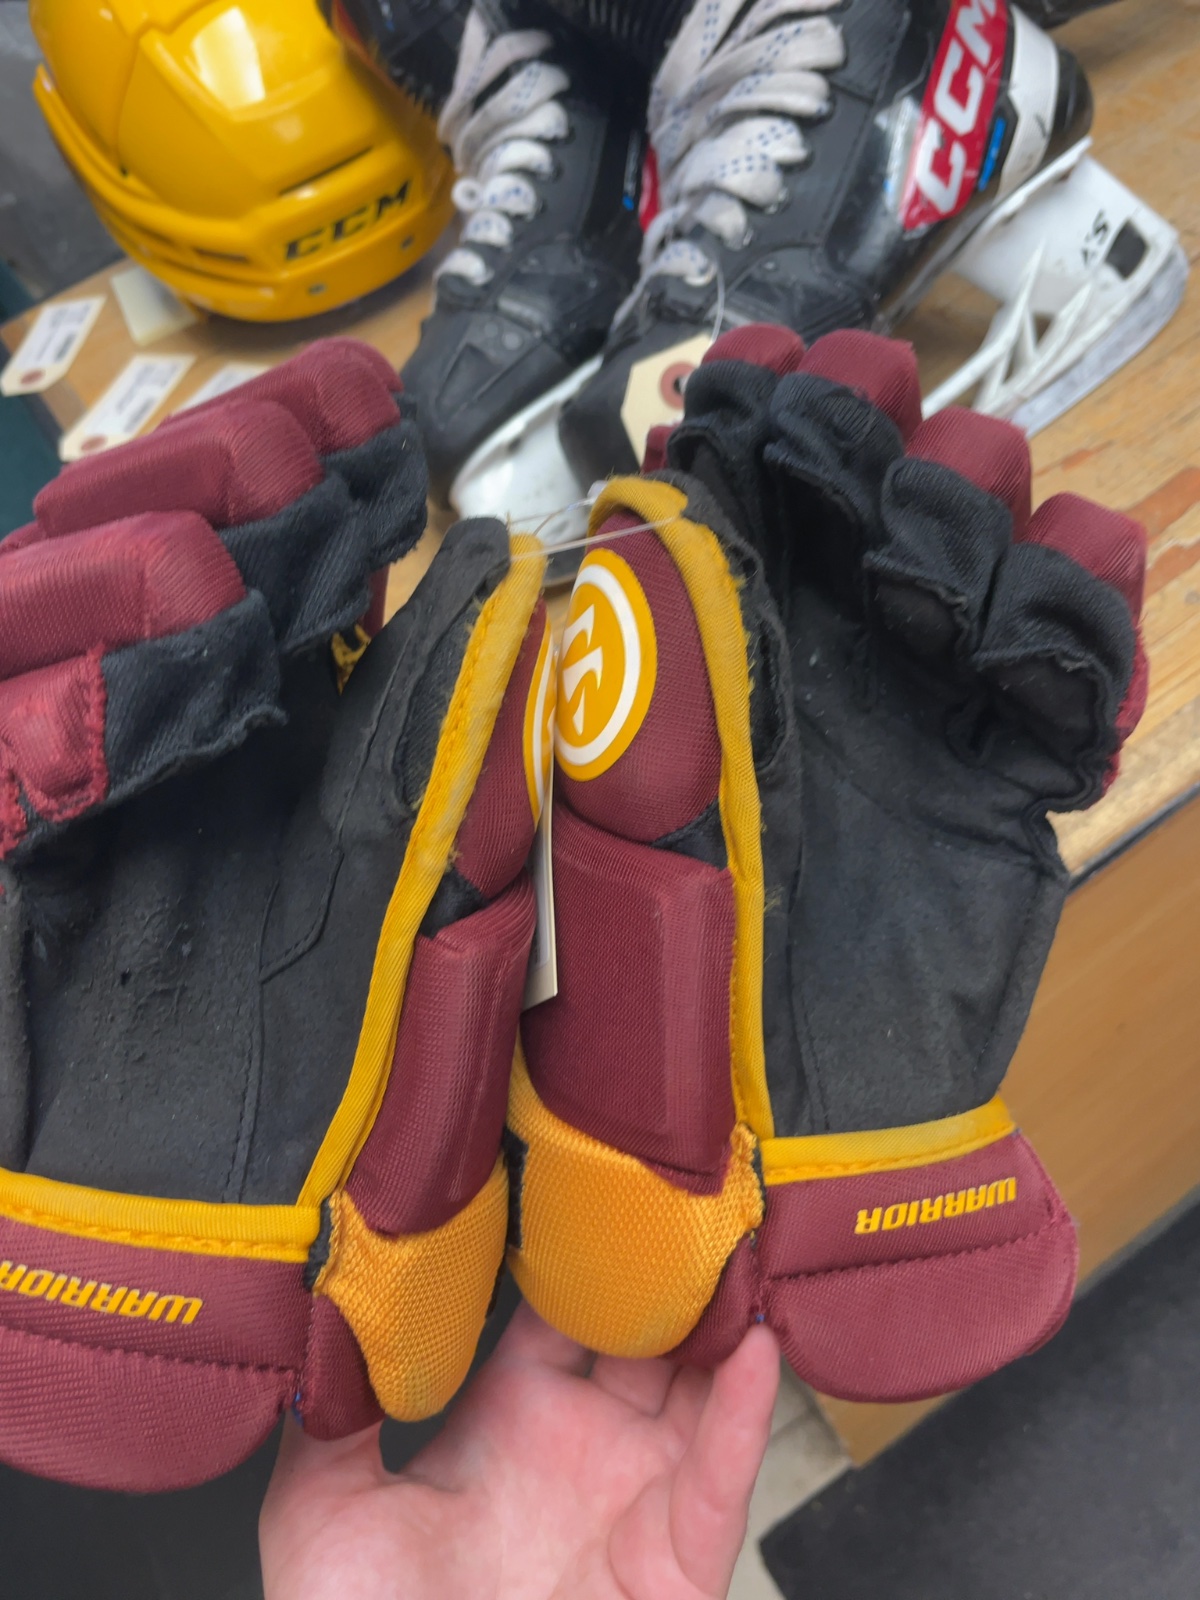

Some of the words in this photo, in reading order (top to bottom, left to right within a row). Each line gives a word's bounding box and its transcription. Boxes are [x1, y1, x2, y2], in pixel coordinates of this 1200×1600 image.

[914, 0, 997, 214] CCM
[285, 180, 410, 261] CCM
[854, 1176, 1017, 1235] WARRIOR
[0, 1260, 203, 1325] WARRIOR
